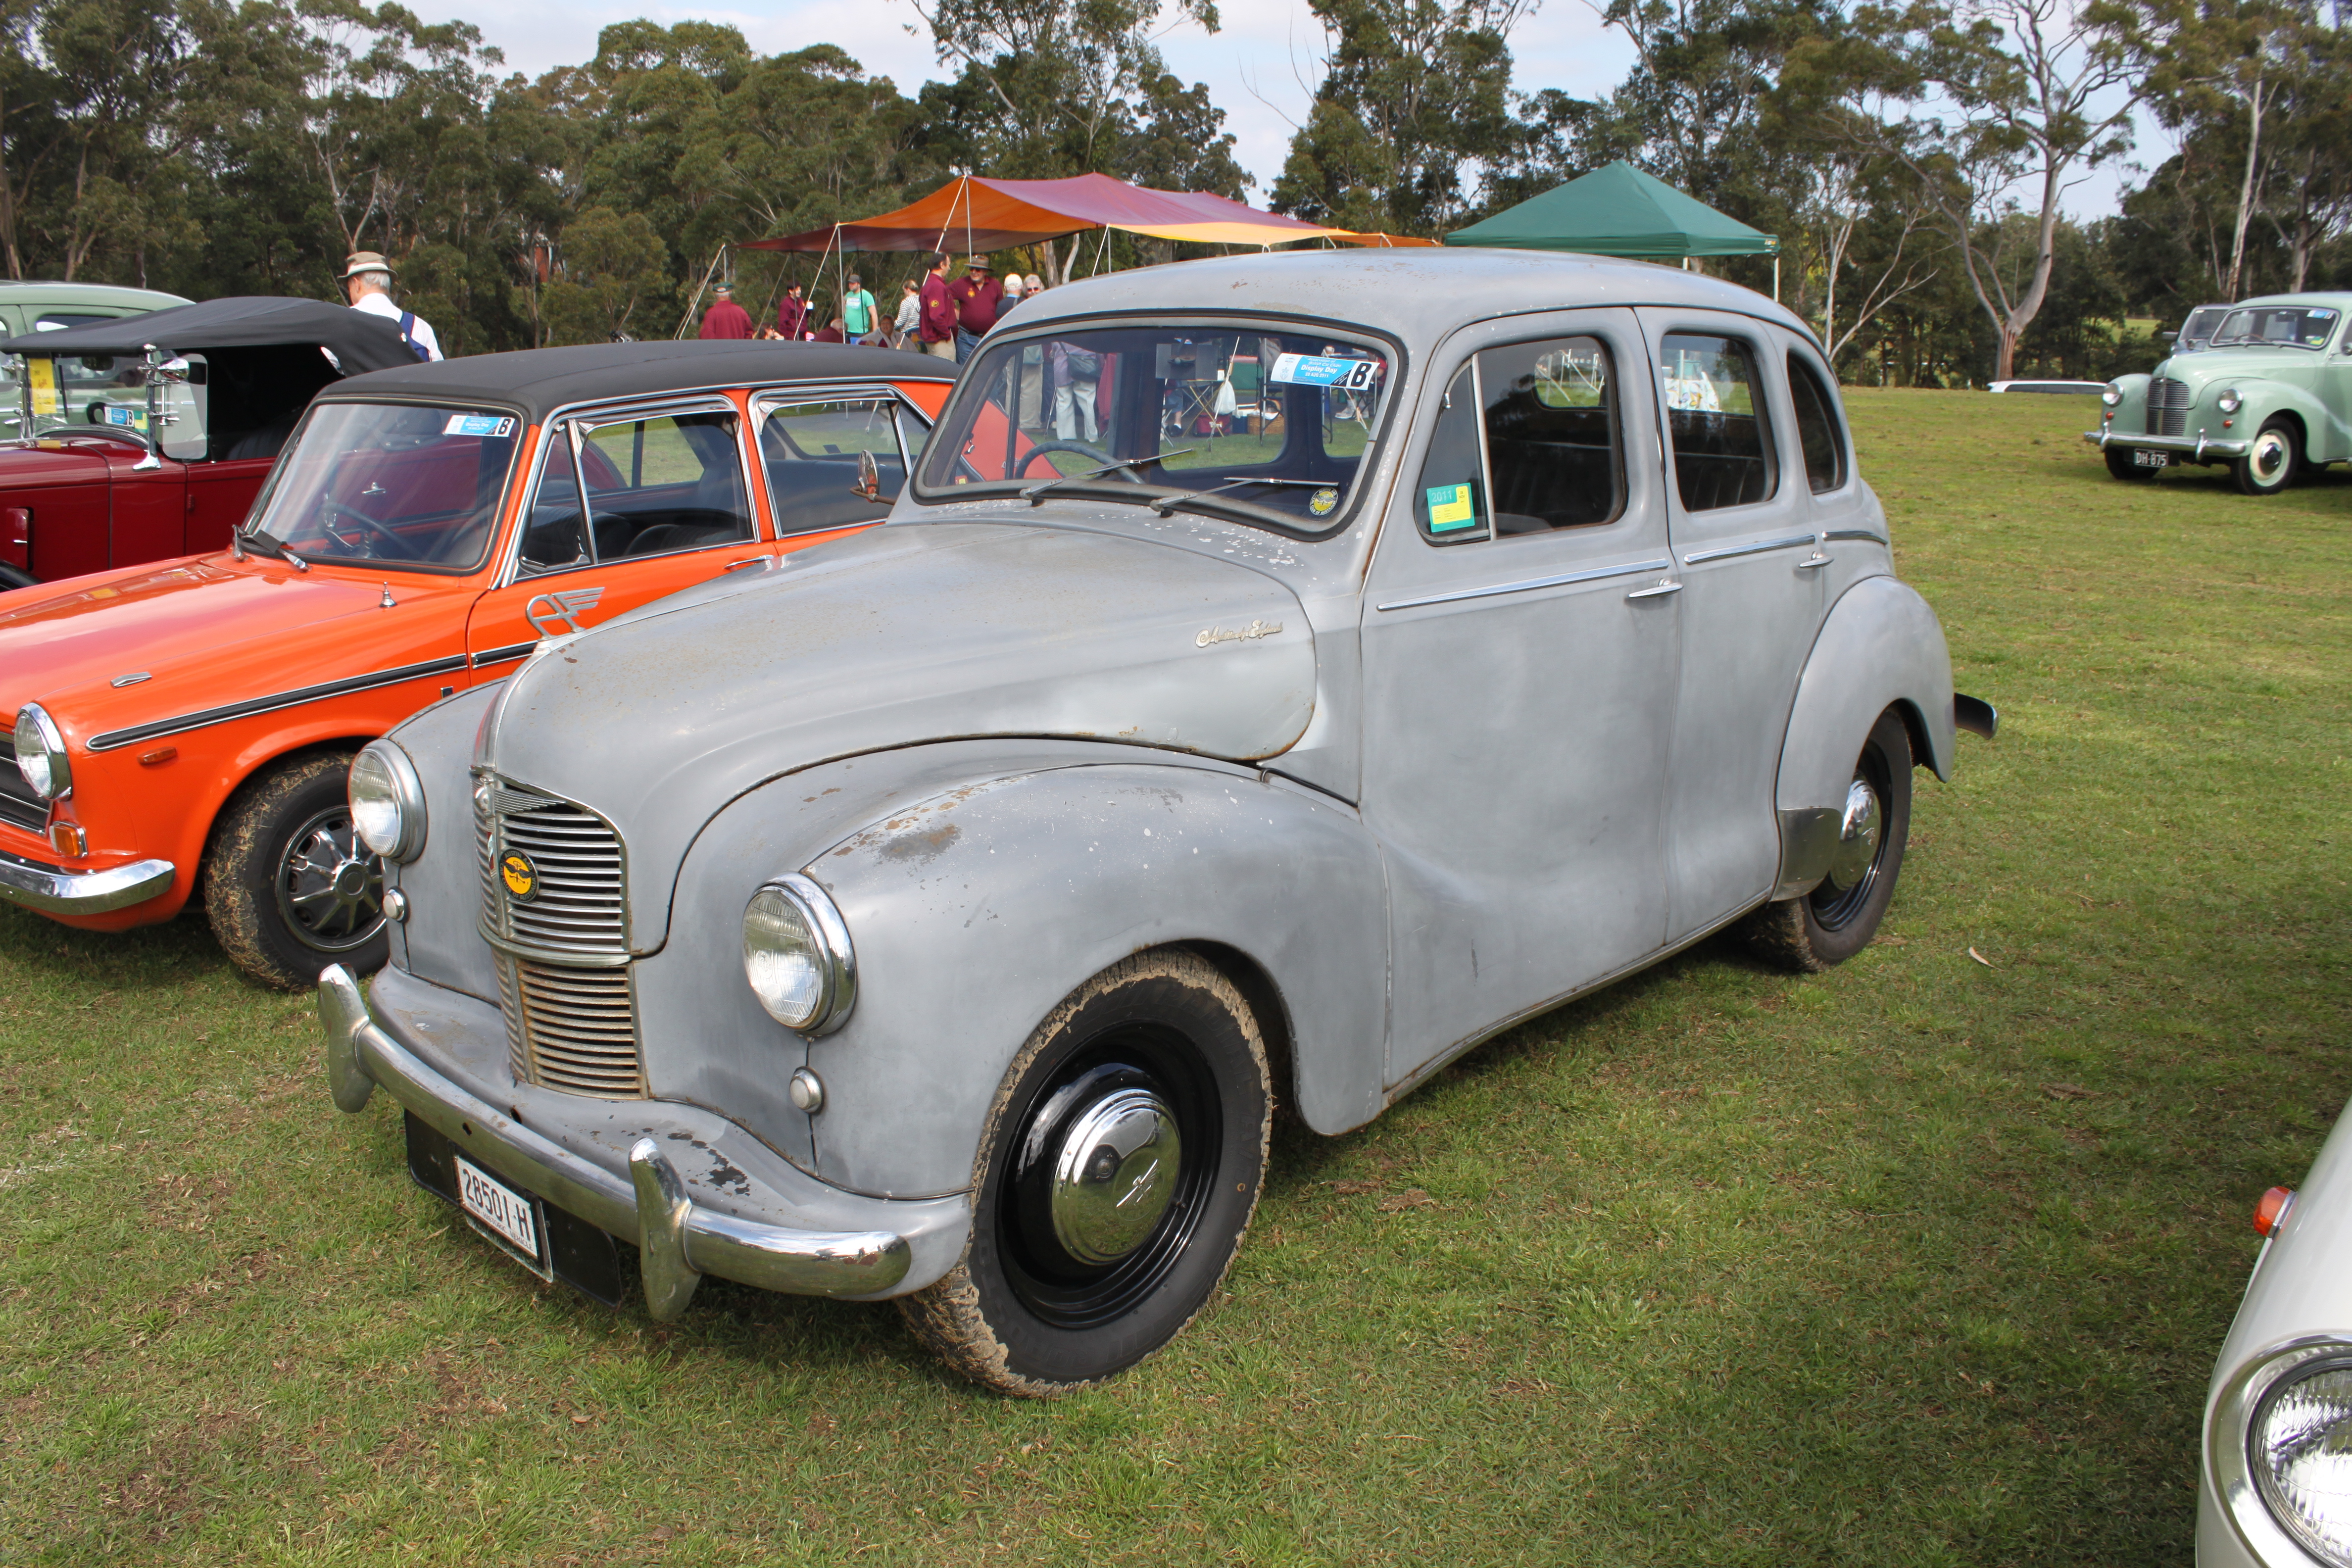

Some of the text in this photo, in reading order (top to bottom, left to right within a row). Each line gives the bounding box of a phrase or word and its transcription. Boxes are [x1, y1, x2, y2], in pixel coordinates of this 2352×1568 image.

[1301, 364, 1324, 373] Display
[1350, 362, 1372, 387] B
[498, 418, 511, 435] B
[1431, 490, 1452, 503] 2011
[505, 850, 533, 870] AUSTIN A40
[502, 878, 512, 893] CLUB
[520, 877, 537, 900] AUSTRALIA
[483, 1211, 507, 1234] HISTORIC
[510, 1230, 534, 1252] VEHICLE
